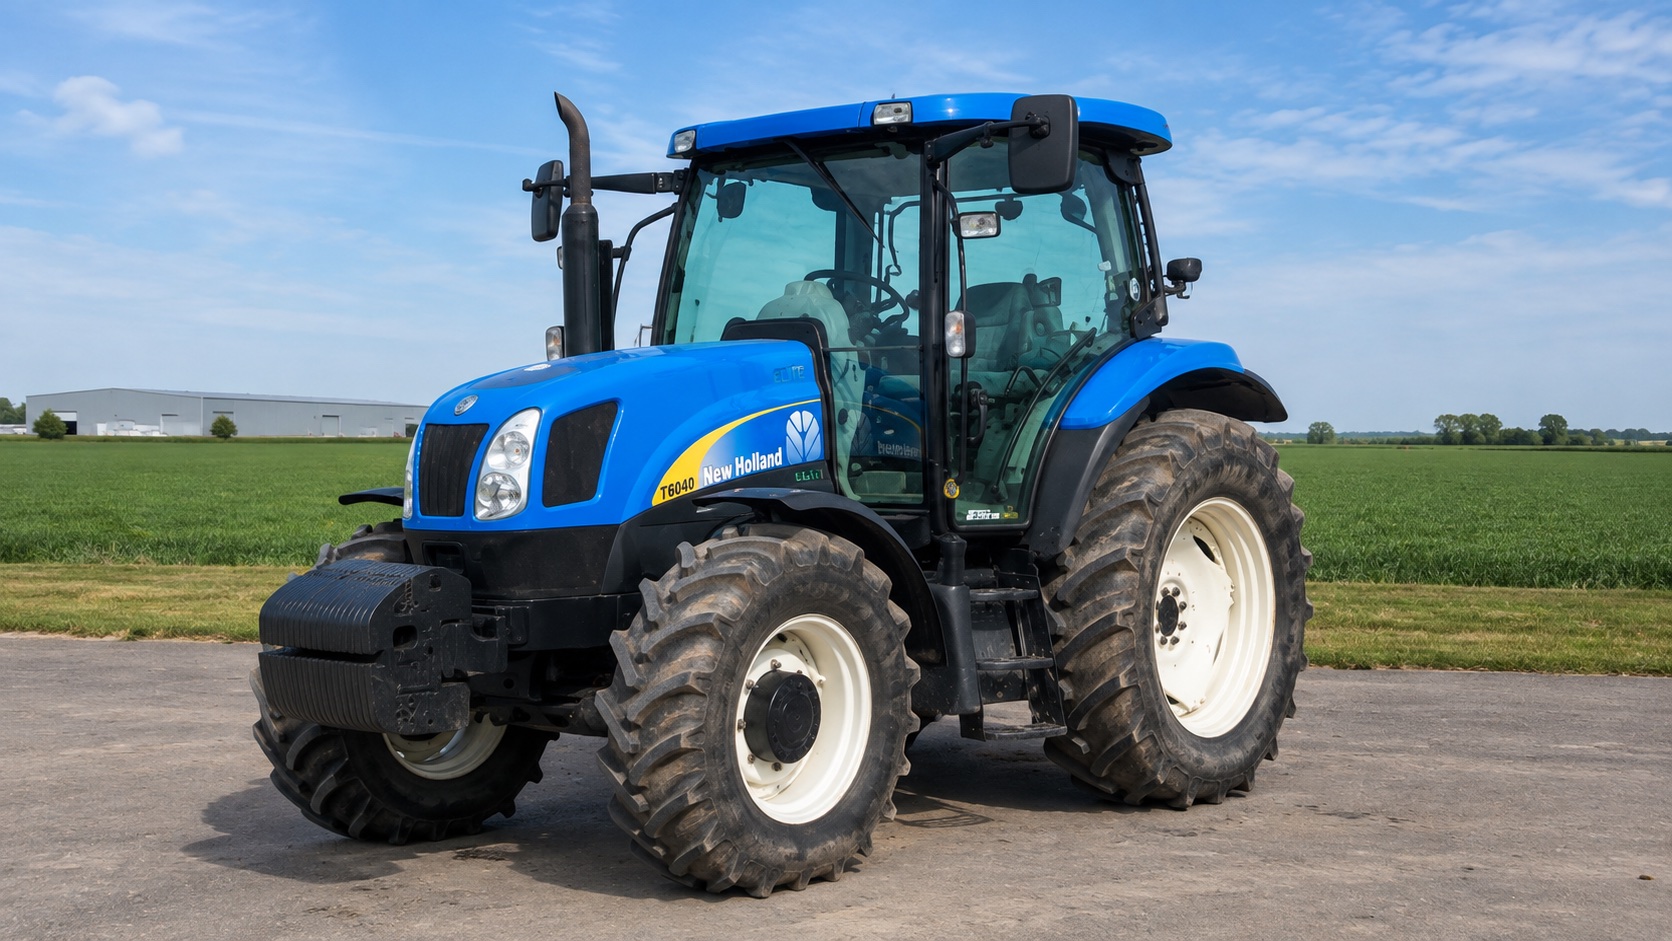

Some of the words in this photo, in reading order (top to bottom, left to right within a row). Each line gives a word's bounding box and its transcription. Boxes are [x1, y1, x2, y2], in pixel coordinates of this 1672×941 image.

[703, 465, 733, 486] New
[735, 447, 783, 477] Holland
[660, 477, 695, 500] T6040
